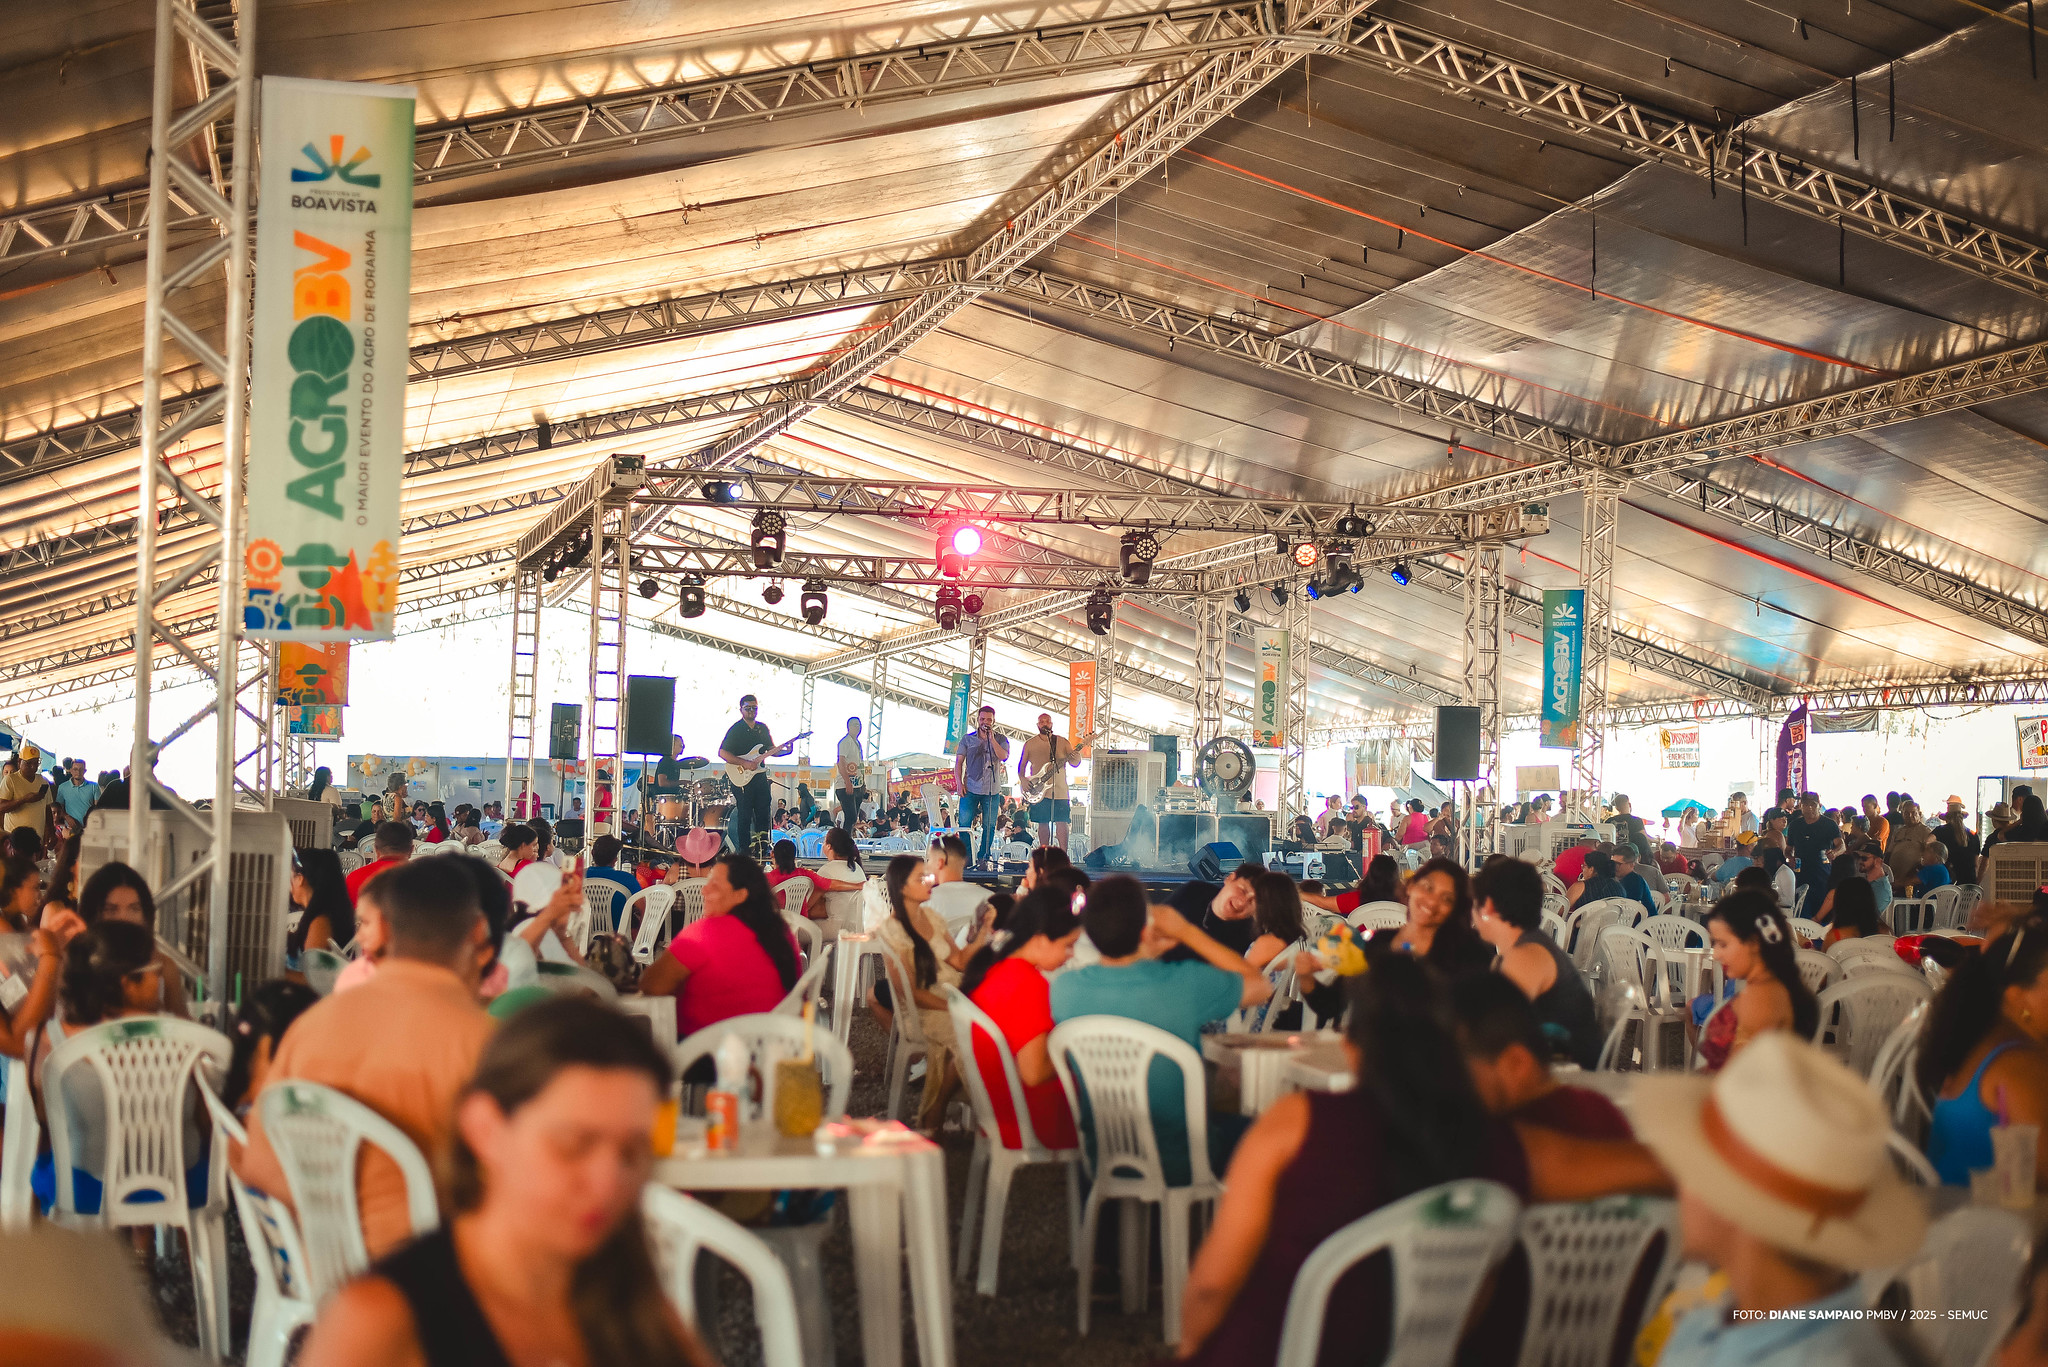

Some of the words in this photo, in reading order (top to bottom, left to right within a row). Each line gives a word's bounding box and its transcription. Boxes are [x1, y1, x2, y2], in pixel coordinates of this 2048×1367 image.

[364, 230, 377, 300] RORAIMA
[364, 304, 376, 323] DE
[363, 328, 375, 369] AGRO
[362, 373, 374, 394] DO
[360, 398, 373, 457] EVENTO
[357, 462, 370, 511] MAIOR
[357, 516, 367, 526] O
[899, 776, 940, 788] BARRACA
